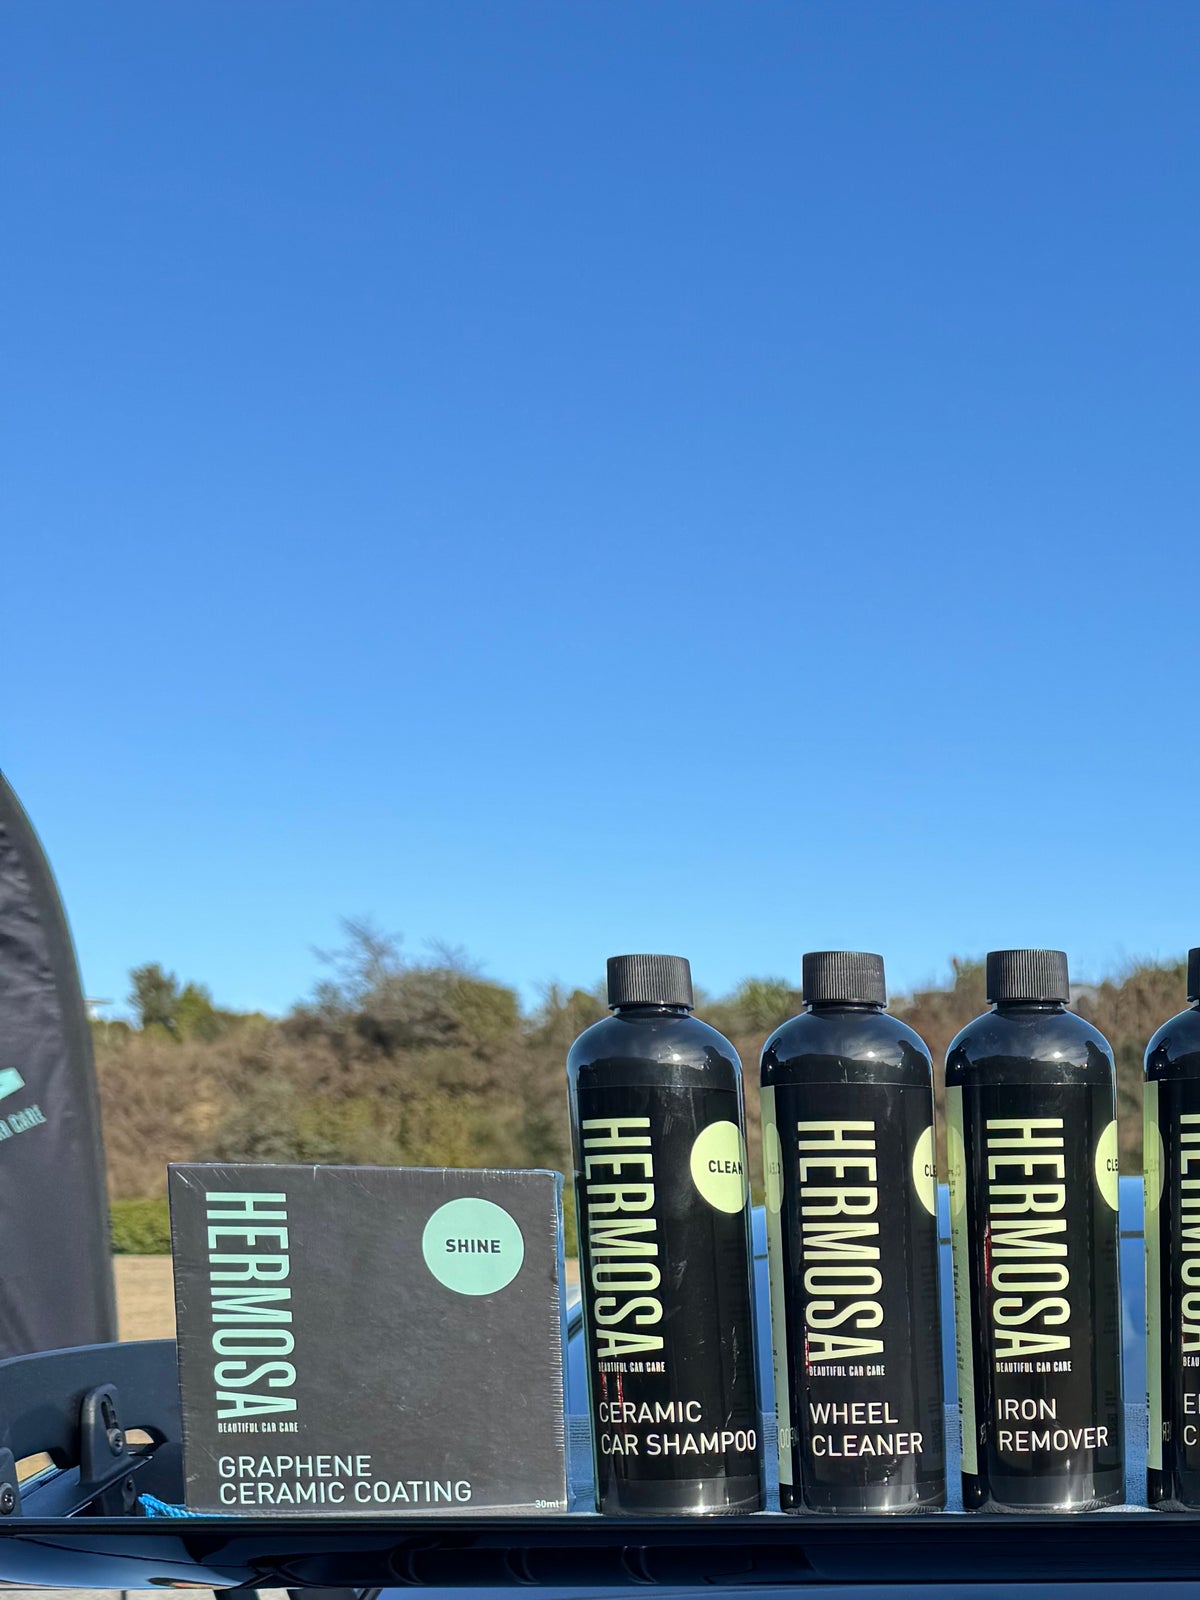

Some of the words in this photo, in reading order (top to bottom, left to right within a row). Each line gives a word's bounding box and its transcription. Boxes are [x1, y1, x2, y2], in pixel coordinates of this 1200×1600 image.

[708, 1160, 743, 1175] CLEAN
[445, 1239, 501, 1254] SHINE
[582, 1117, 665, 1358] HERMOSA
[797, 1120, 884, 1361] HERMOSA
[986, 1118, 1071, 1358] HERMOSA
[206, 1191, 298, 1419] HERMOSA
[809, 1365, 847, 1375] BEAUTIFUL
[849, 1365, 864, 1375] CAR
[867, 1364, 885, 1375] CARE
[996, 1361, 1034, 1372] BEAUTIFUL
[1036, 1361, 1051, 1372] CAR
[1054, 1360, 1072, 1372] CARE
[599, 1401, 702, 1424] CERAMIC
[809, 1402, 898, 1424] WHEEL
[997, 1398, 1057, 1421] IRON
[218, 1422, 259, 1433] BEAUTIFUL
[261, 1422, 276, 1433] CAR
[279, 1421, 299, 1433] CARE
[601, 1434, 640, 1455] CAR
[646, 1429, 756, 1455] SHAMPOO
[812, 1433, 923, 1456] CLEANER
[999, 1429, 1108, 1452] REMOVER
[218, 1455, 371, 1478] GRAPHENE
[220, 1483, 345, 1505] CERAMIC
[354, 1480, 472, 1503] COATING
[535, 1499, 560, 1509] 30ml
